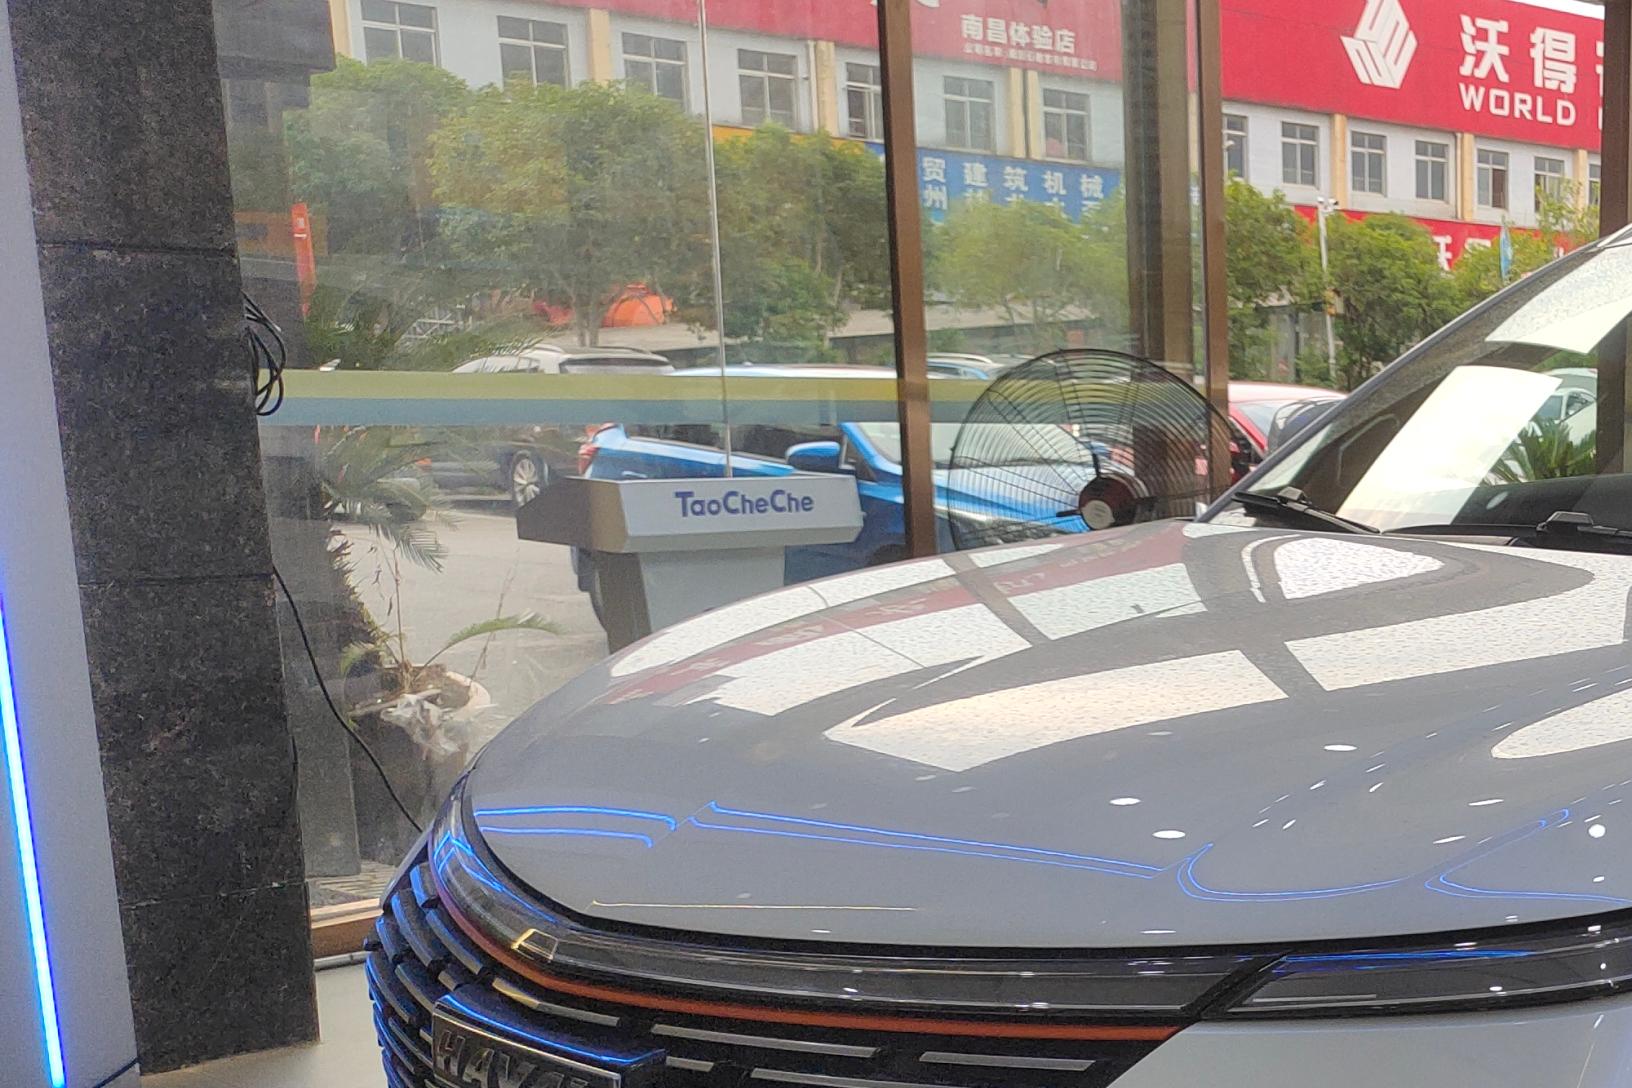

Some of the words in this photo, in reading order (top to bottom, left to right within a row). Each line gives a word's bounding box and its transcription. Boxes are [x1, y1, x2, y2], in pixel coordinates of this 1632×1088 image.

[960, 14, 1076, 54] 南昌体验店
[1459, 83, 1576, 126] WORLD
[675, 489, 814, 517] TaoCheChe
